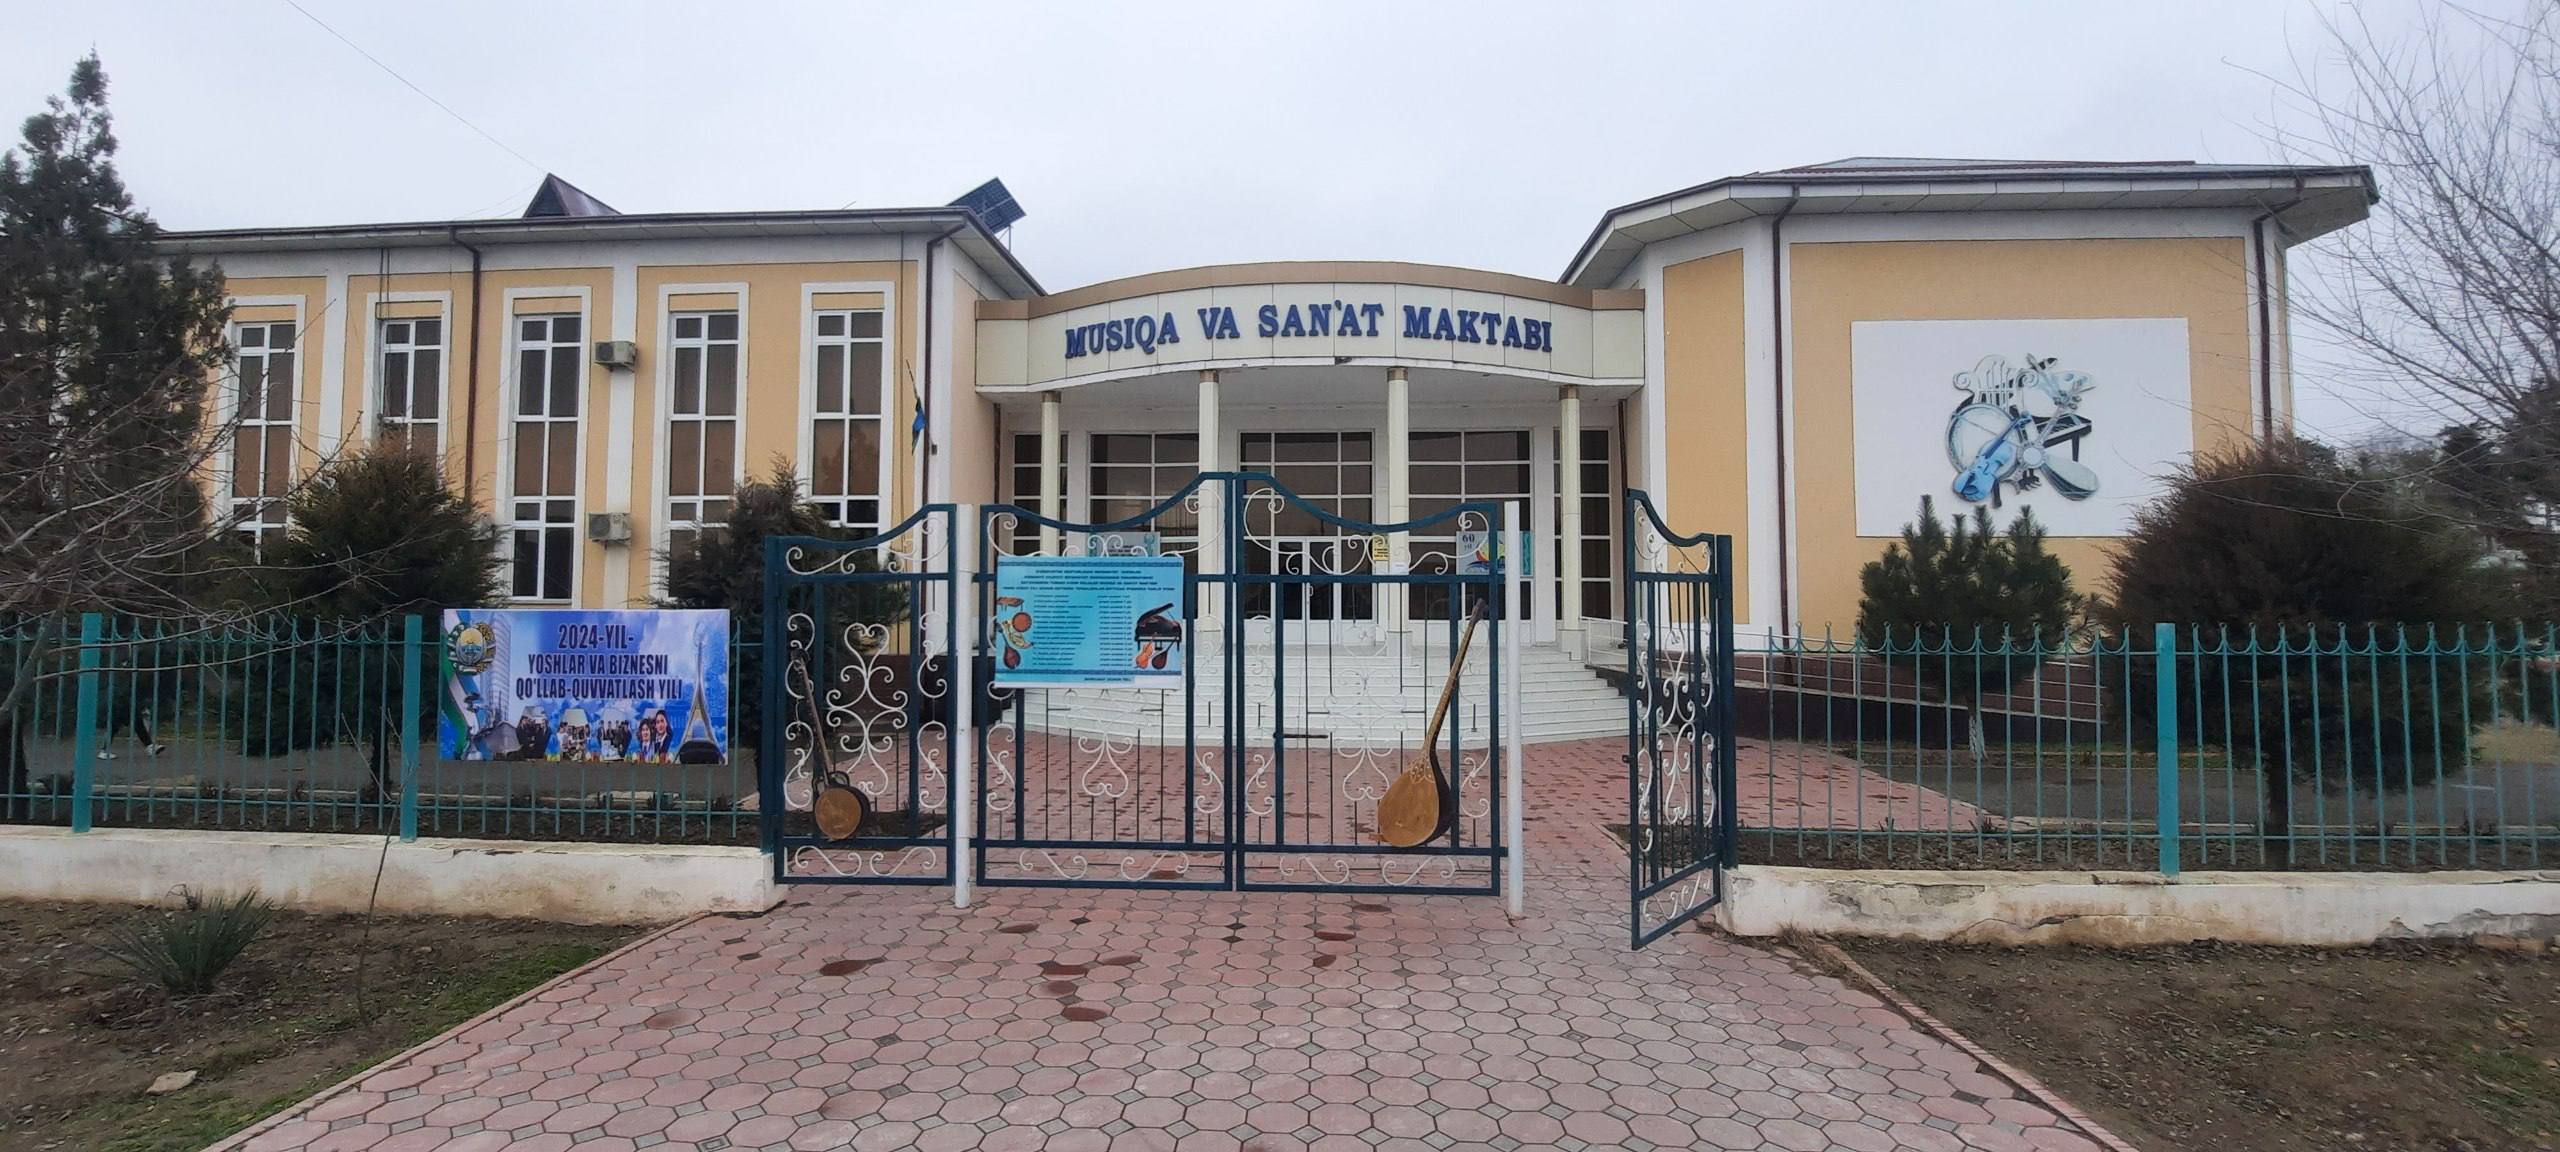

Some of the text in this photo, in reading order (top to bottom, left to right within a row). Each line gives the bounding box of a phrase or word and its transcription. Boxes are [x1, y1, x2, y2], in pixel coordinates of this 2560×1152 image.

[1065, 299, 1552, 359] MUSIQA VA SAN'AT MAKTABI
[558, 624, 634, 649] 2024-YIL-
[528, 654, 668, 675] YOSHLAR VA BIZNESNI
[516, 678, 683, 700] QO'LLAB-QUVVATLASH YILI
